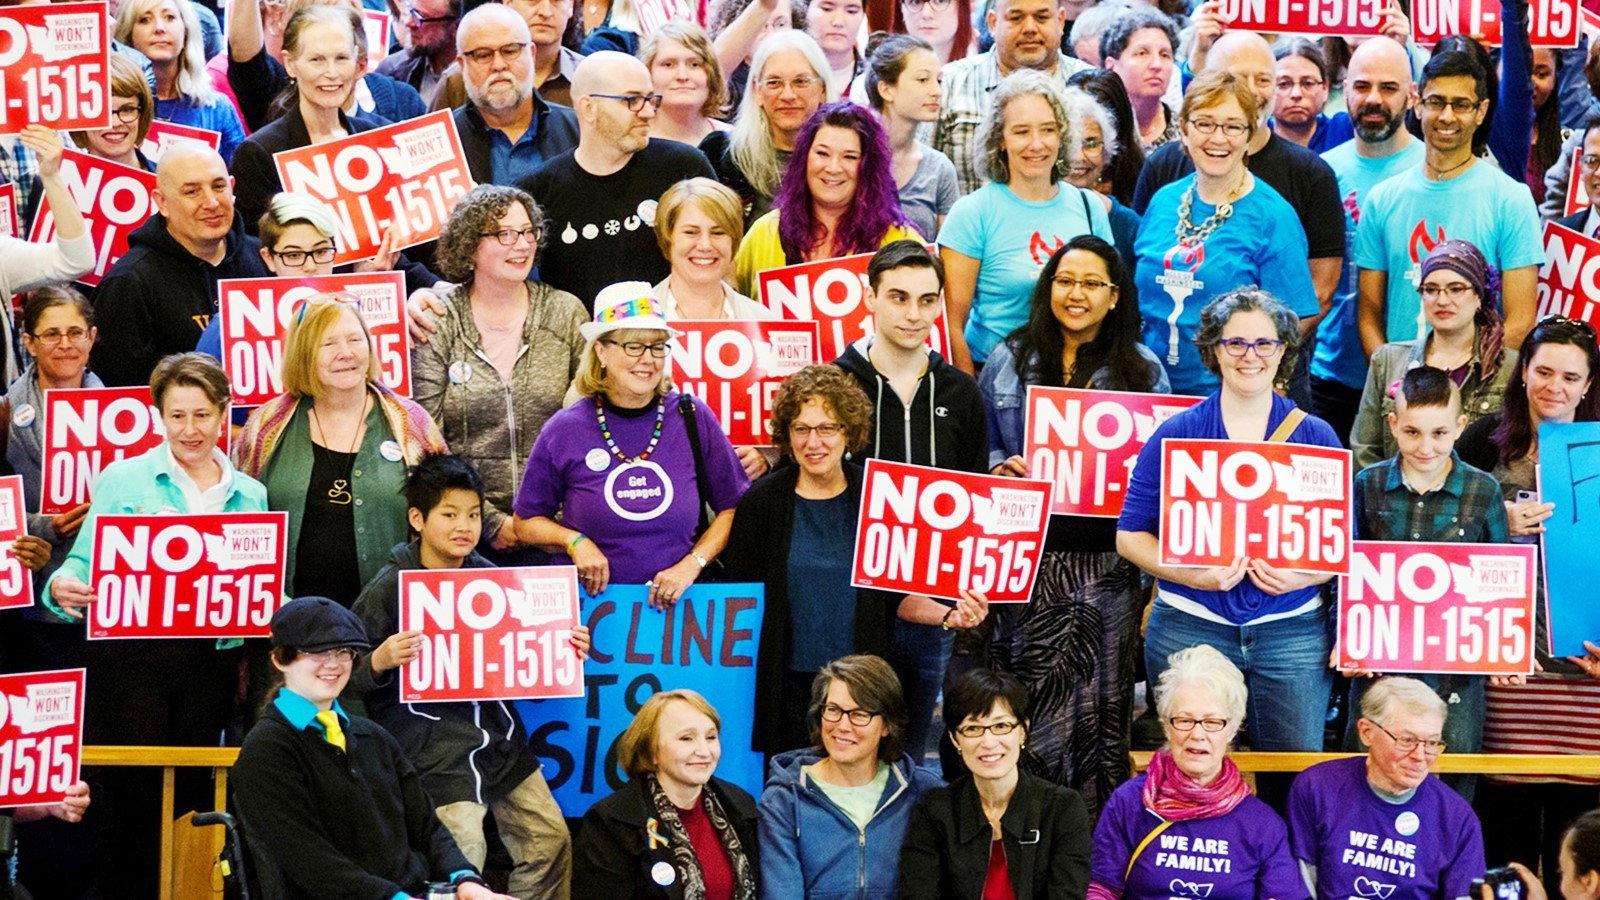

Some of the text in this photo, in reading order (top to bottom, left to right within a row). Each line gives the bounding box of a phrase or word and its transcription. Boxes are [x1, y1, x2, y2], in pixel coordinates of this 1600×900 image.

[55, 27, 93, 42] WON'T
[406, 135, 446, 158] WON'T
[285, 145, 384, 200] NO
[766, 268, 863, 320] NO
[231, 340, 284, 396] ON
[664, 330, 754, 379] NO
[778, 345, 808, 359] WON'T
[52, 397, 150, 448] NO
[1033, 397, 1134, 450] NO
[616, 486, 661, 500] engaged
[628, 476, 647, 487] Get
[1170, 449, 1274, 500] NO
[1302, 470, 1337, 486] WON'T
[868, 471, 971, 530] NO
[1000, 502, 1036, 519] WON'T
[100, 524, 204, 572] NO
[232, 537, 271, 551] WON'T
[1169, 500, 1345, 563] ON I-1515
[863, 522, 1036, 594] ON I-1515
[1348, 552, 1452, 603] NO
[1480, 569, 1519, 584] WON'T
[97, 573, 276, 628] ON I-1515
[408, 579, 507, 631] NO
[532, 592, 566, 607] WON'T
[583, 597, 757, 667] CLINE
[1347, 603, 1526, 664] ON I-1515
[409, 630, 576, 691] ON I-1515
[35, 696, 70, 713] WON'T
[0, 735, 74, 796] 1515
[1156, 852, 1231, 873] FAMILY!
[1160, 834, 1229, 855] WE ARE
[1342, 848, 1416, 878] FAMILY!
[1350, 830, 1416, 859] WE ARE
